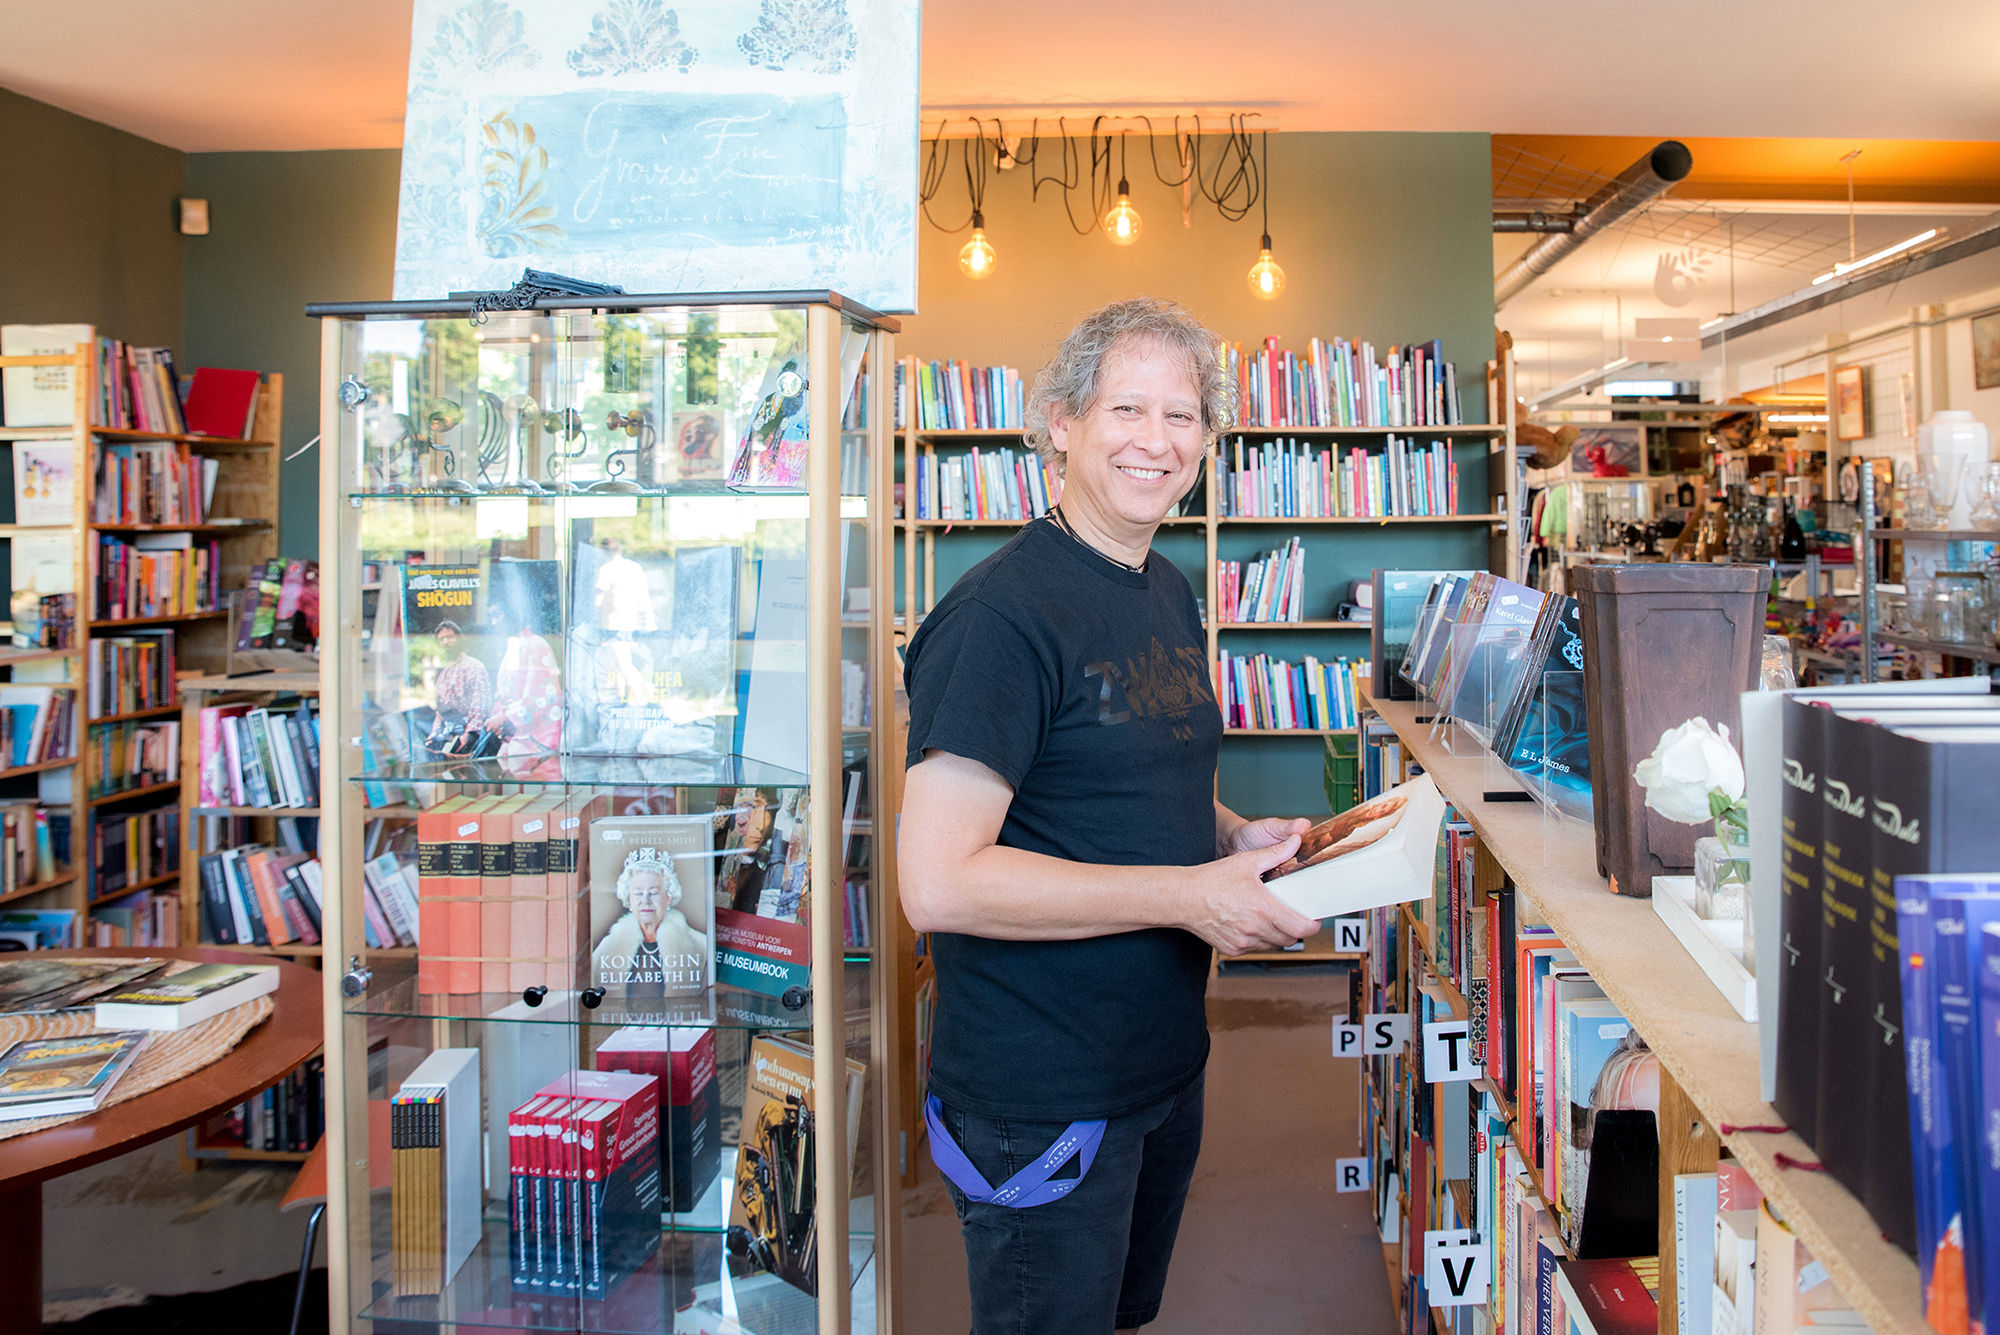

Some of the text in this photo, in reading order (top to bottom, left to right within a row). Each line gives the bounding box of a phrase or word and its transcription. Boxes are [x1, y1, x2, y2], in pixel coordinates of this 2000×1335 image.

[1520, 748, 1570, 773] E L James
[1342, 926, 1360, 946] N
[600, 953, 701, 969] KONINGIN
[723, 953, 790, 980] MUSEUMBOOK
[600, 970, 701, 984] ELIZABETH II
[1340, 1031, 1356, 1052] P
[1375, 1021, 1394, 1049] S
[1438, 1032, 1467, 1071] T
[789, 1085, 802, 1099] nu
[1043, 1136, 1077, 1169] WELZORG
[1345, 1166, 1360, 1187] R
[1441, 1258, 1475, 1296] V
[1543, 1257, 1551, 1304] ESTHER
